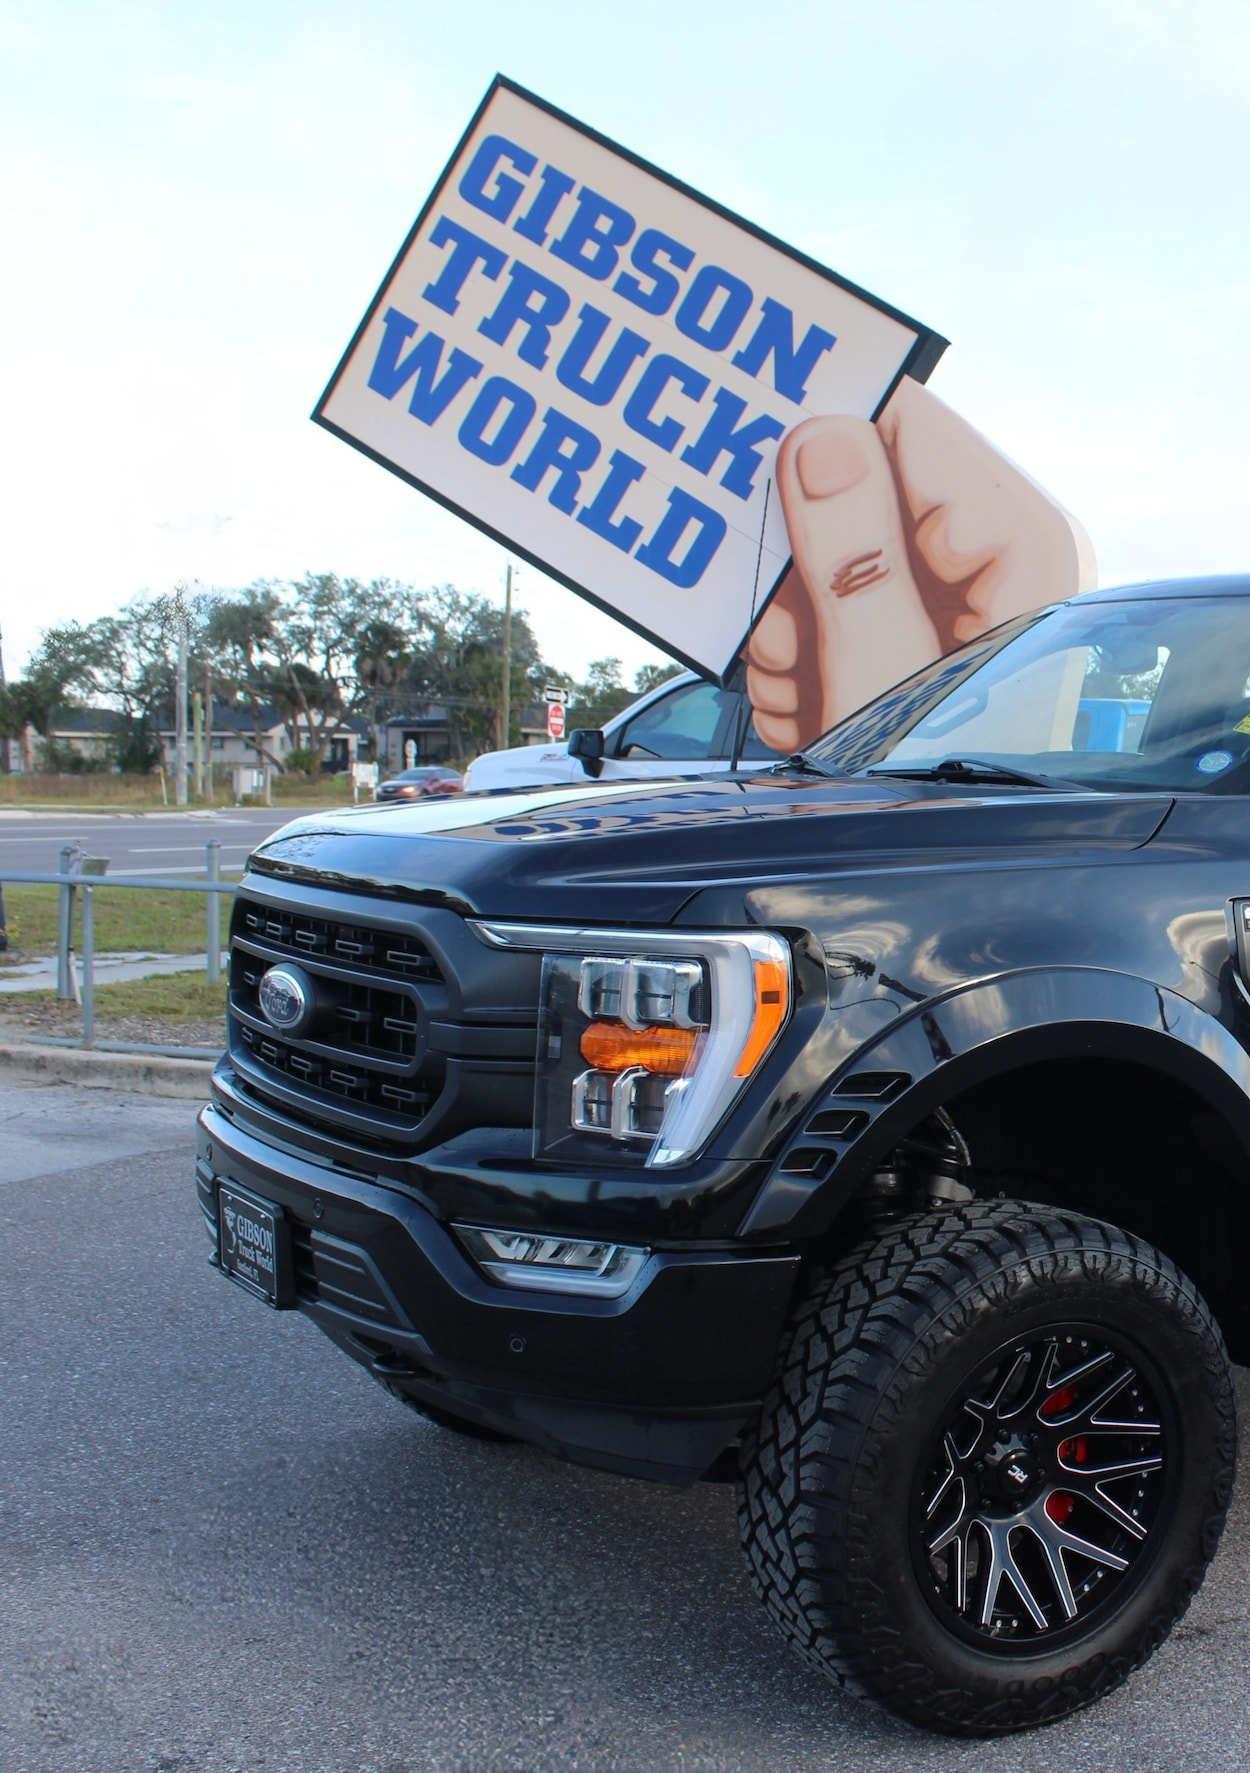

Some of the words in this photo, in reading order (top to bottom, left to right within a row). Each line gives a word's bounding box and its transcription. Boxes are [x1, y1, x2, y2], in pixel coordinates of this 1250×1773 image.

[458, 134, 837, 405] GIBSON
[421, 215, 786, 501] TRUCK
[366, 306, 728, 590] WORLD
[237, 1215, 273, 1254] GIBSON
[238, 1240, 255, 1262] Truck
[256, 1250, 273, 1273] World
[1007, 1464, 1028, 1483] RC
